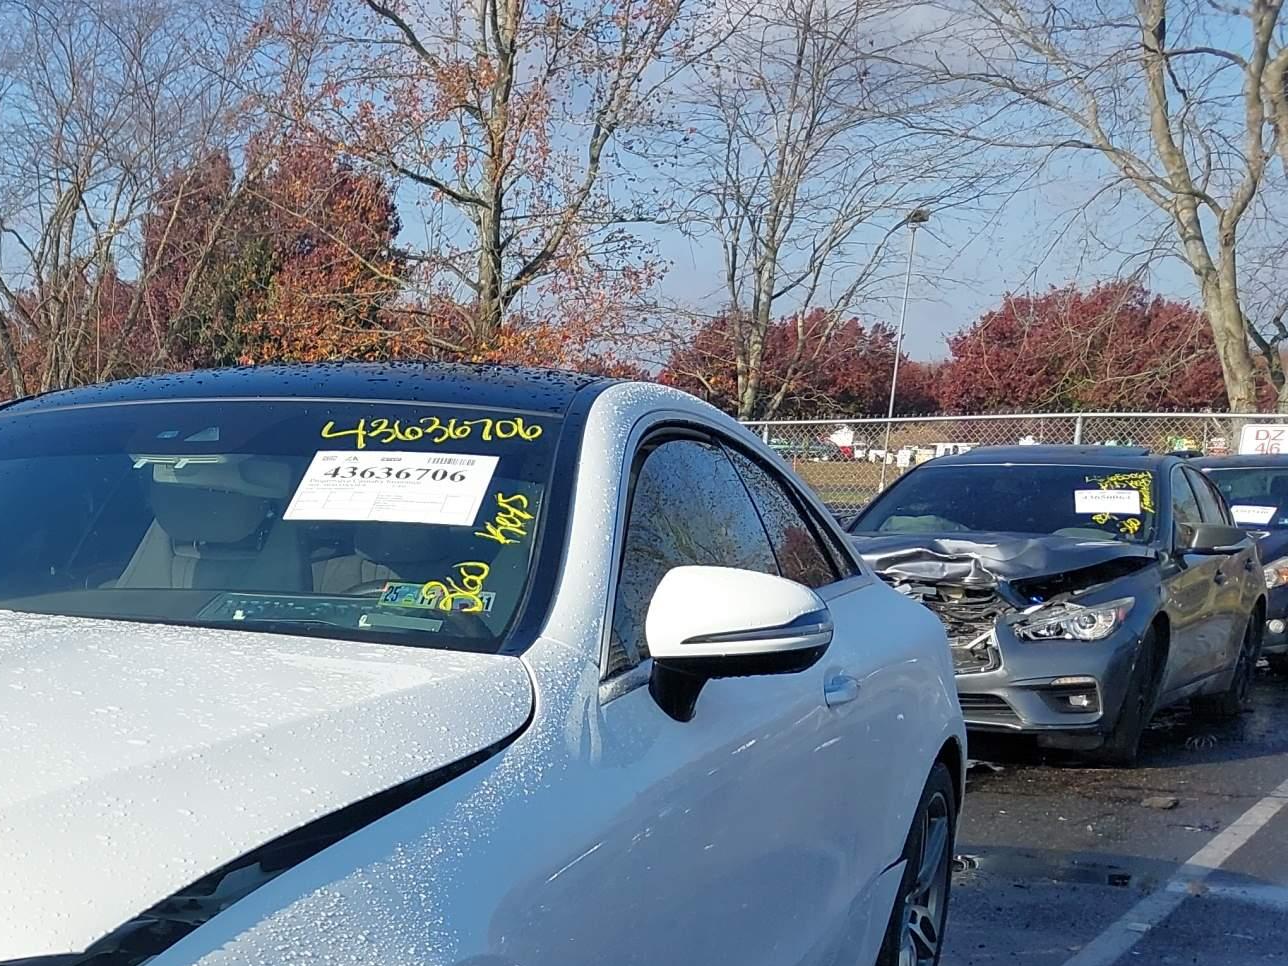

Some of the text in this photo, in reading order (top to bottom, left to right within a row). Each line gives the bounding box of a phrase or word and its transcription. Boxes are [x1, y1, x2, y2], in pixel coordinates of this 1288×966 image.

[321, 418, 542, 448] 43636706
[323, 466, 468, 483] 43636706
[384, 585, 402, 602] 25
